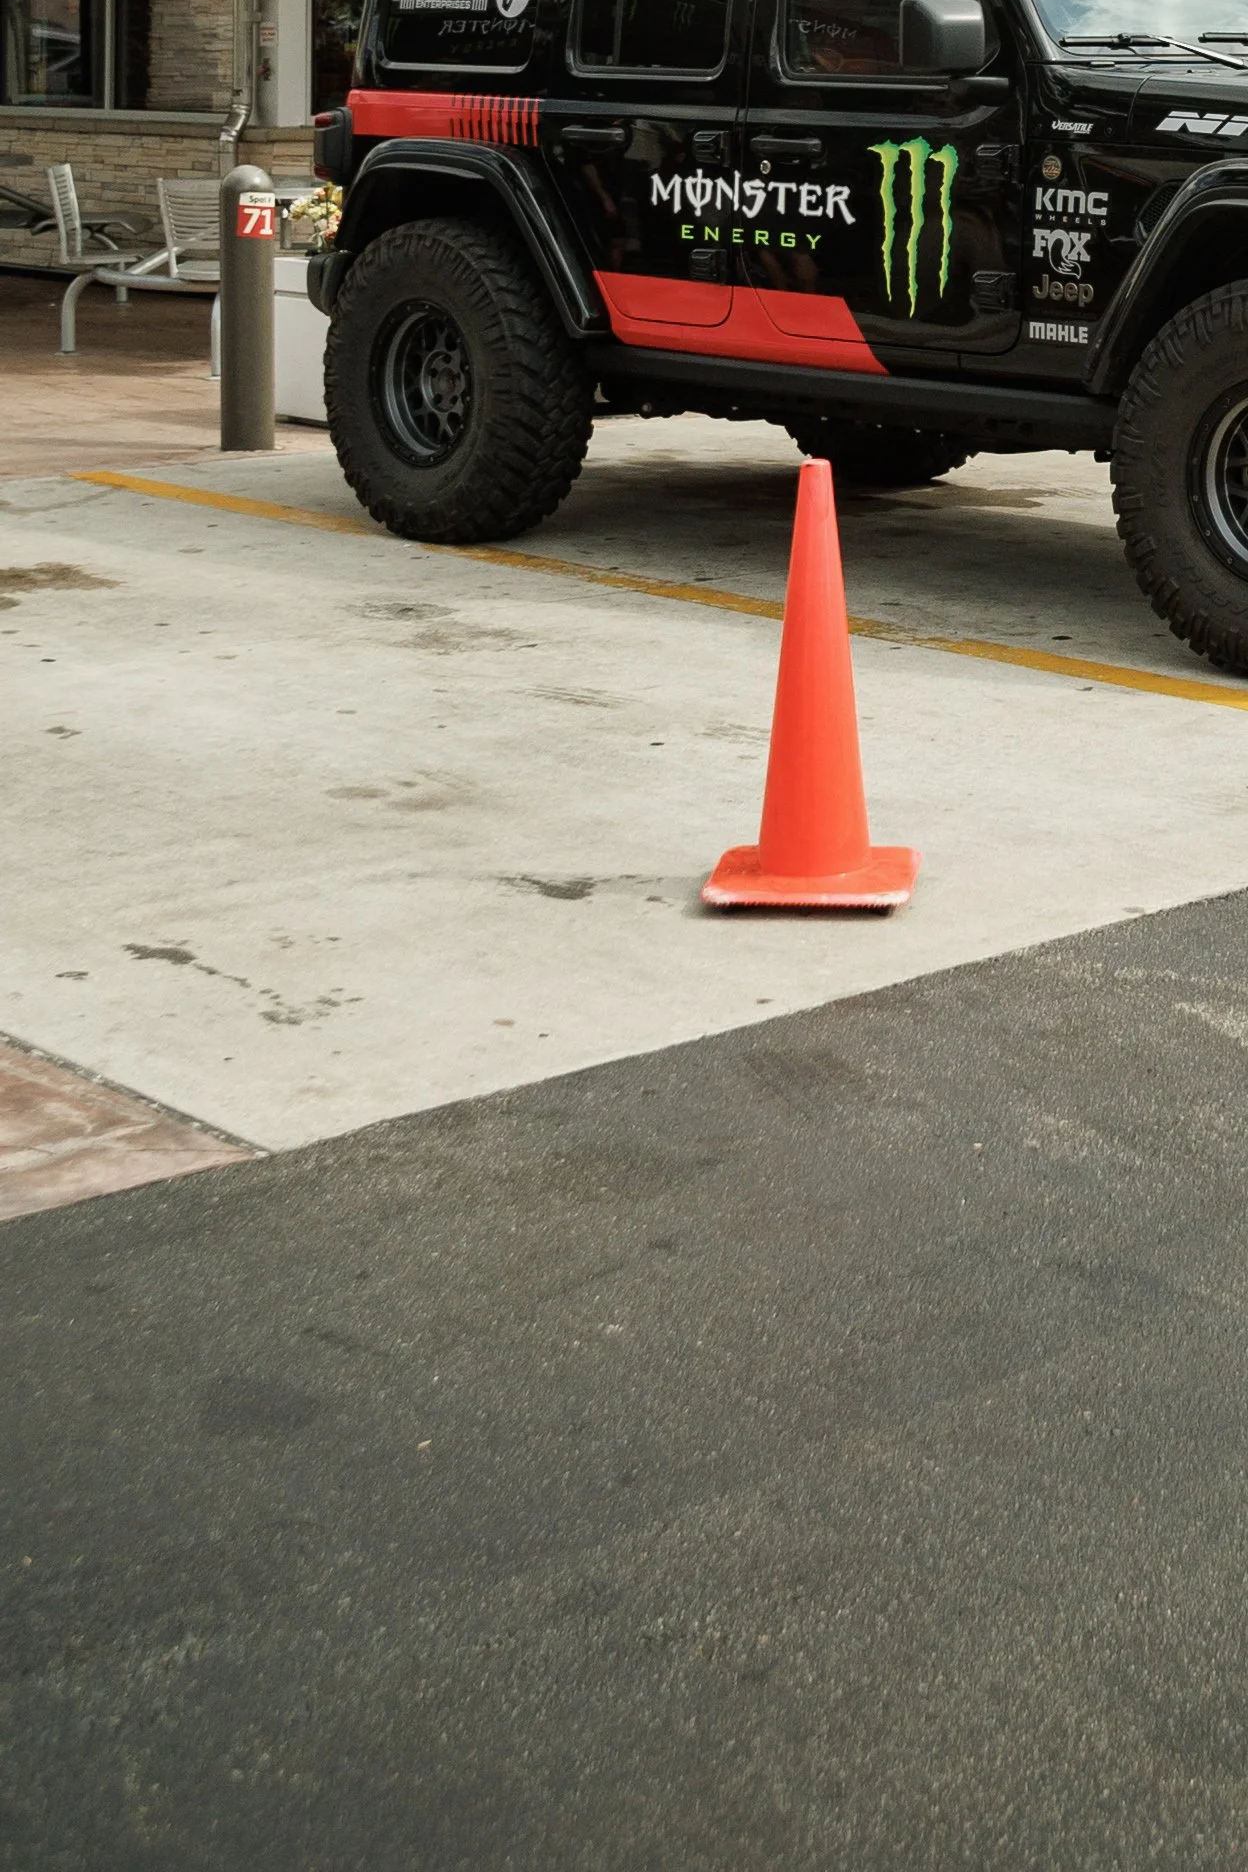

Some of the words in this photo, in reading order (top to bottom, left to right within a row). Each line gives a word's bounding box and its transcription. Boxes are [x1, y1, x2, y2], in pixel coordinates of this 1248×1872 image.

[415, 0, 472, 10] ENTERPRISES
[650, 168, 856, 225] MONSTER
[1035, 187, 1109, 216] KMC
[242, 208, 273, 235] 71
[1035, 214, 1107, 226] WHEELS
[681, 224, 822, 249] ENERGY
[1032, 228, 1091, 270] FOX
[1032, 274, 1094, 307] Jeep
[1029, 321, 1088, 344] MAHLE
